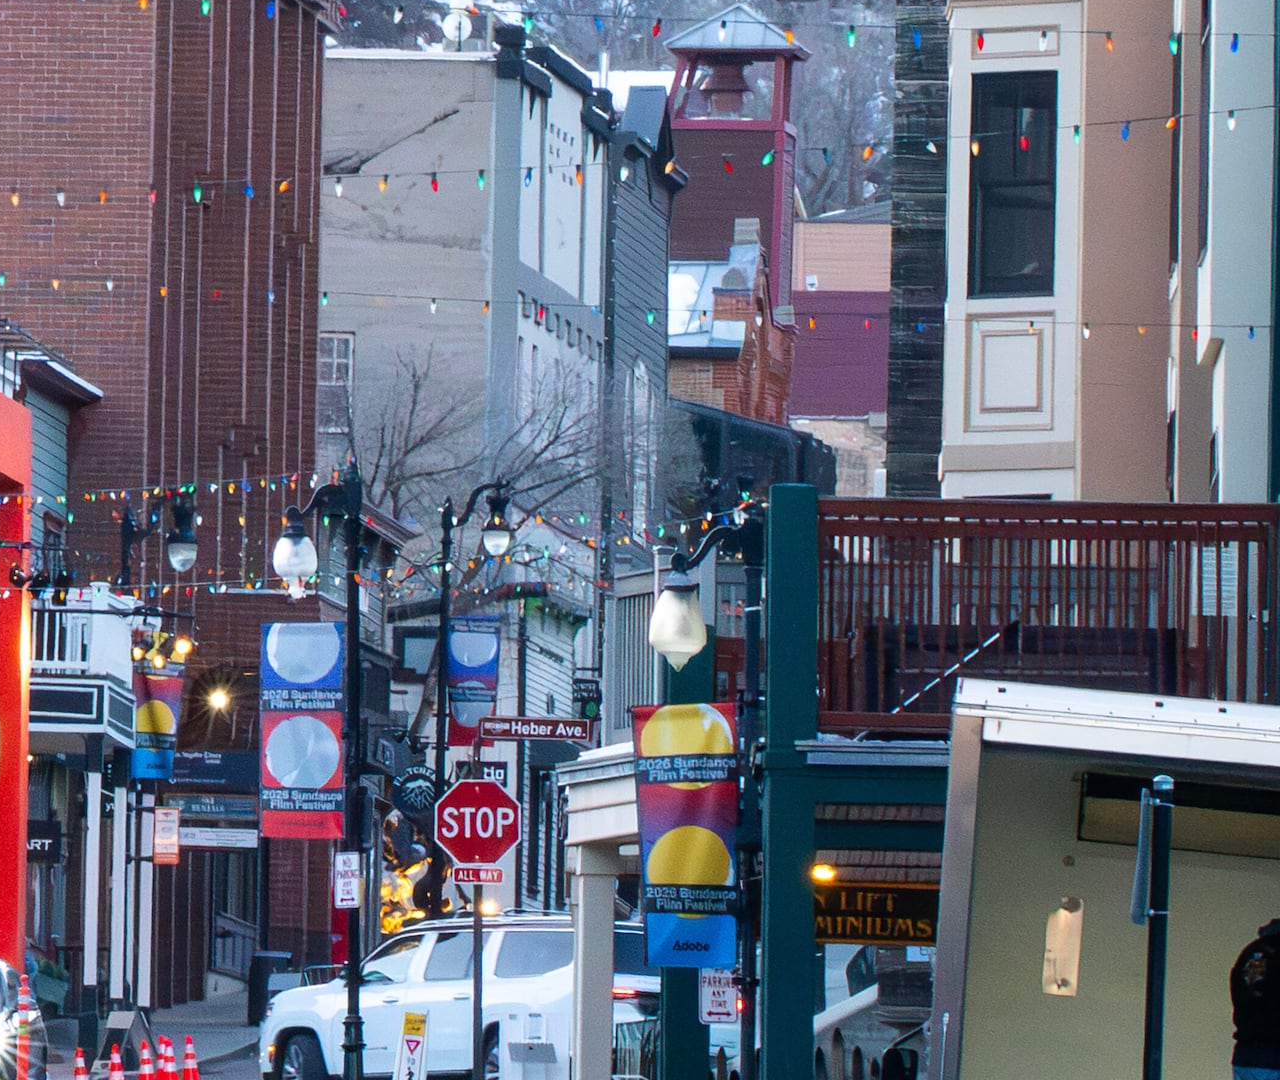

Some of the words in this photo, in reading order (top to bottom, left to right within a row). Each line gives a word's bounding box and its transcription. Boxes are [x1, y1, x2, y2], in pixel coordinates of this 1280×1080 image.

[511, 721, 552, 736] Heber
[555, 722, 587, 738] Ave.
[638, 758, 671, 770] 2026
[674, 756, 737, 769] Sundance
[648, 769, 678, 782] Film
[680, 768, 728, 780] Festival
[441, 806, 515, 839] STOP
[457, 871, 476, 882] ALL
[479, 871, 501, 882] WAY
[841, 891, 897, 913] LIFT
[815, 916, 933, 938] MINIUMS
[672, 939, 711, 953] Adobe
